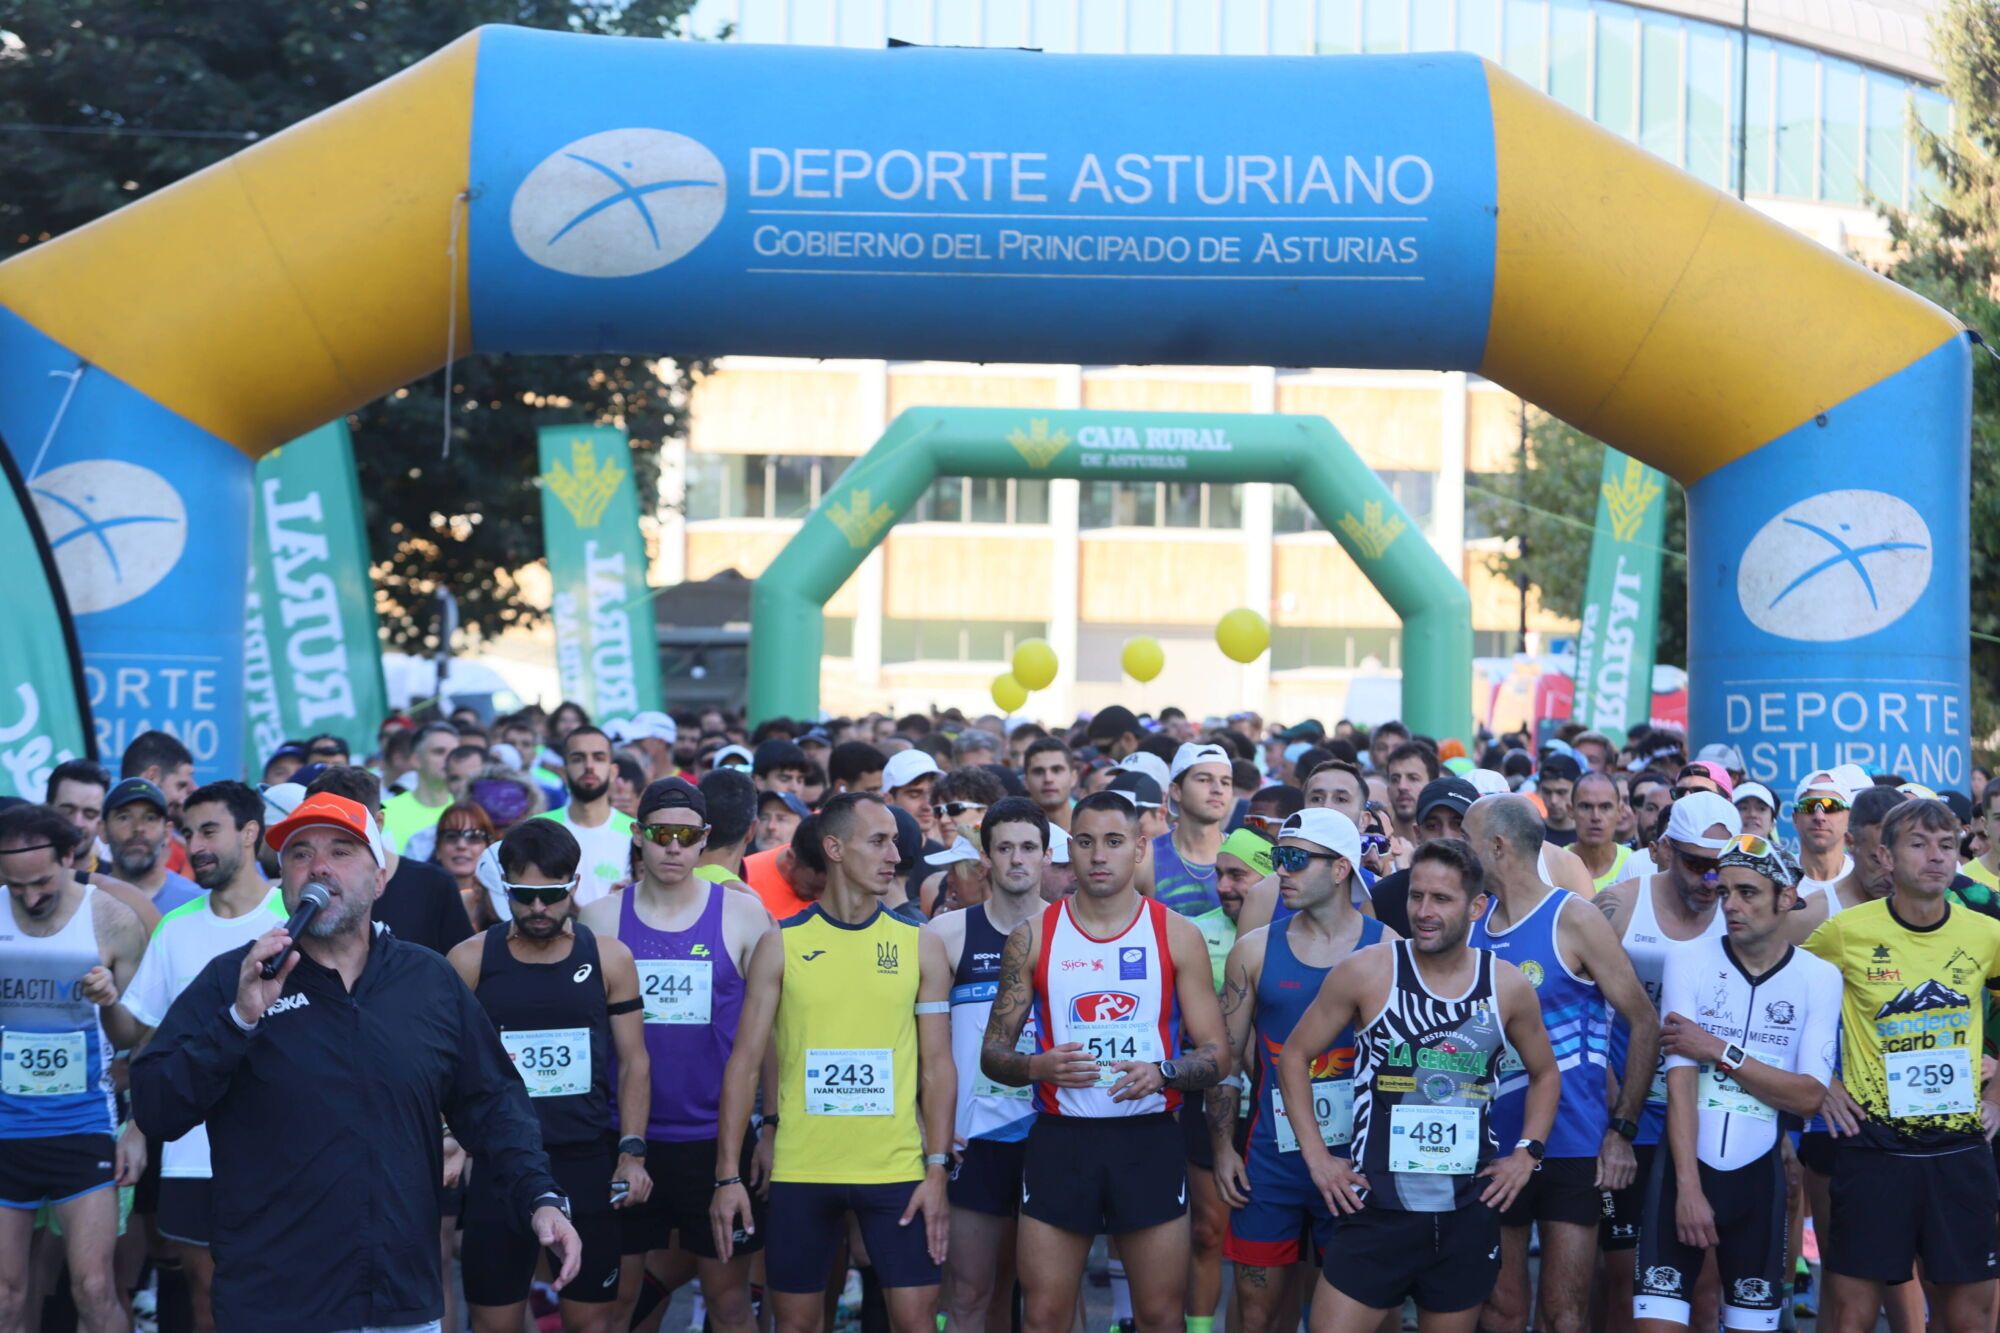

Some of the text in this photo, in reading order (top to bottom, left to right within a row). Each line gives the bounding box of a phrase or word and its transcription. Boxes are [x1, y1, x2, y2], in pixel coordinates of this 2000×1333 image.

[749, 147, 1434, 205] DEPORTE ASTURIANO
[753, 225, 1418, 263] GOBIERNO DEL PRINCIPADO DE ASTURIAS
[1077, 426, 1232, 451] CAJA RURAL
[1727, 691, 1960, 735] DEPORTE
[645, 974, 693, 996] 244
[1876, 1011, 1970, 1037] senderos
[1088, 1036, 1137, 1058] 514
[1419, 1030, 1479, 1050] RESTAURANTE
[1749, 1030, 1791, 1047] MIERES
[20, 1048, 68, 1069] 356
[522, 1045, 571, 1069] 353
[1388, 1038, 1412, 1067] LA
[824, 1064, 874, 1086] 243
[1906, 1063, 1954, 1087] 259
[813, 1087, 886, 1095] IVAN KUZMENKO
[1409, 1121, 1457, 1145] 481
[1419, 1145, 1451, 1153] ROMEO
